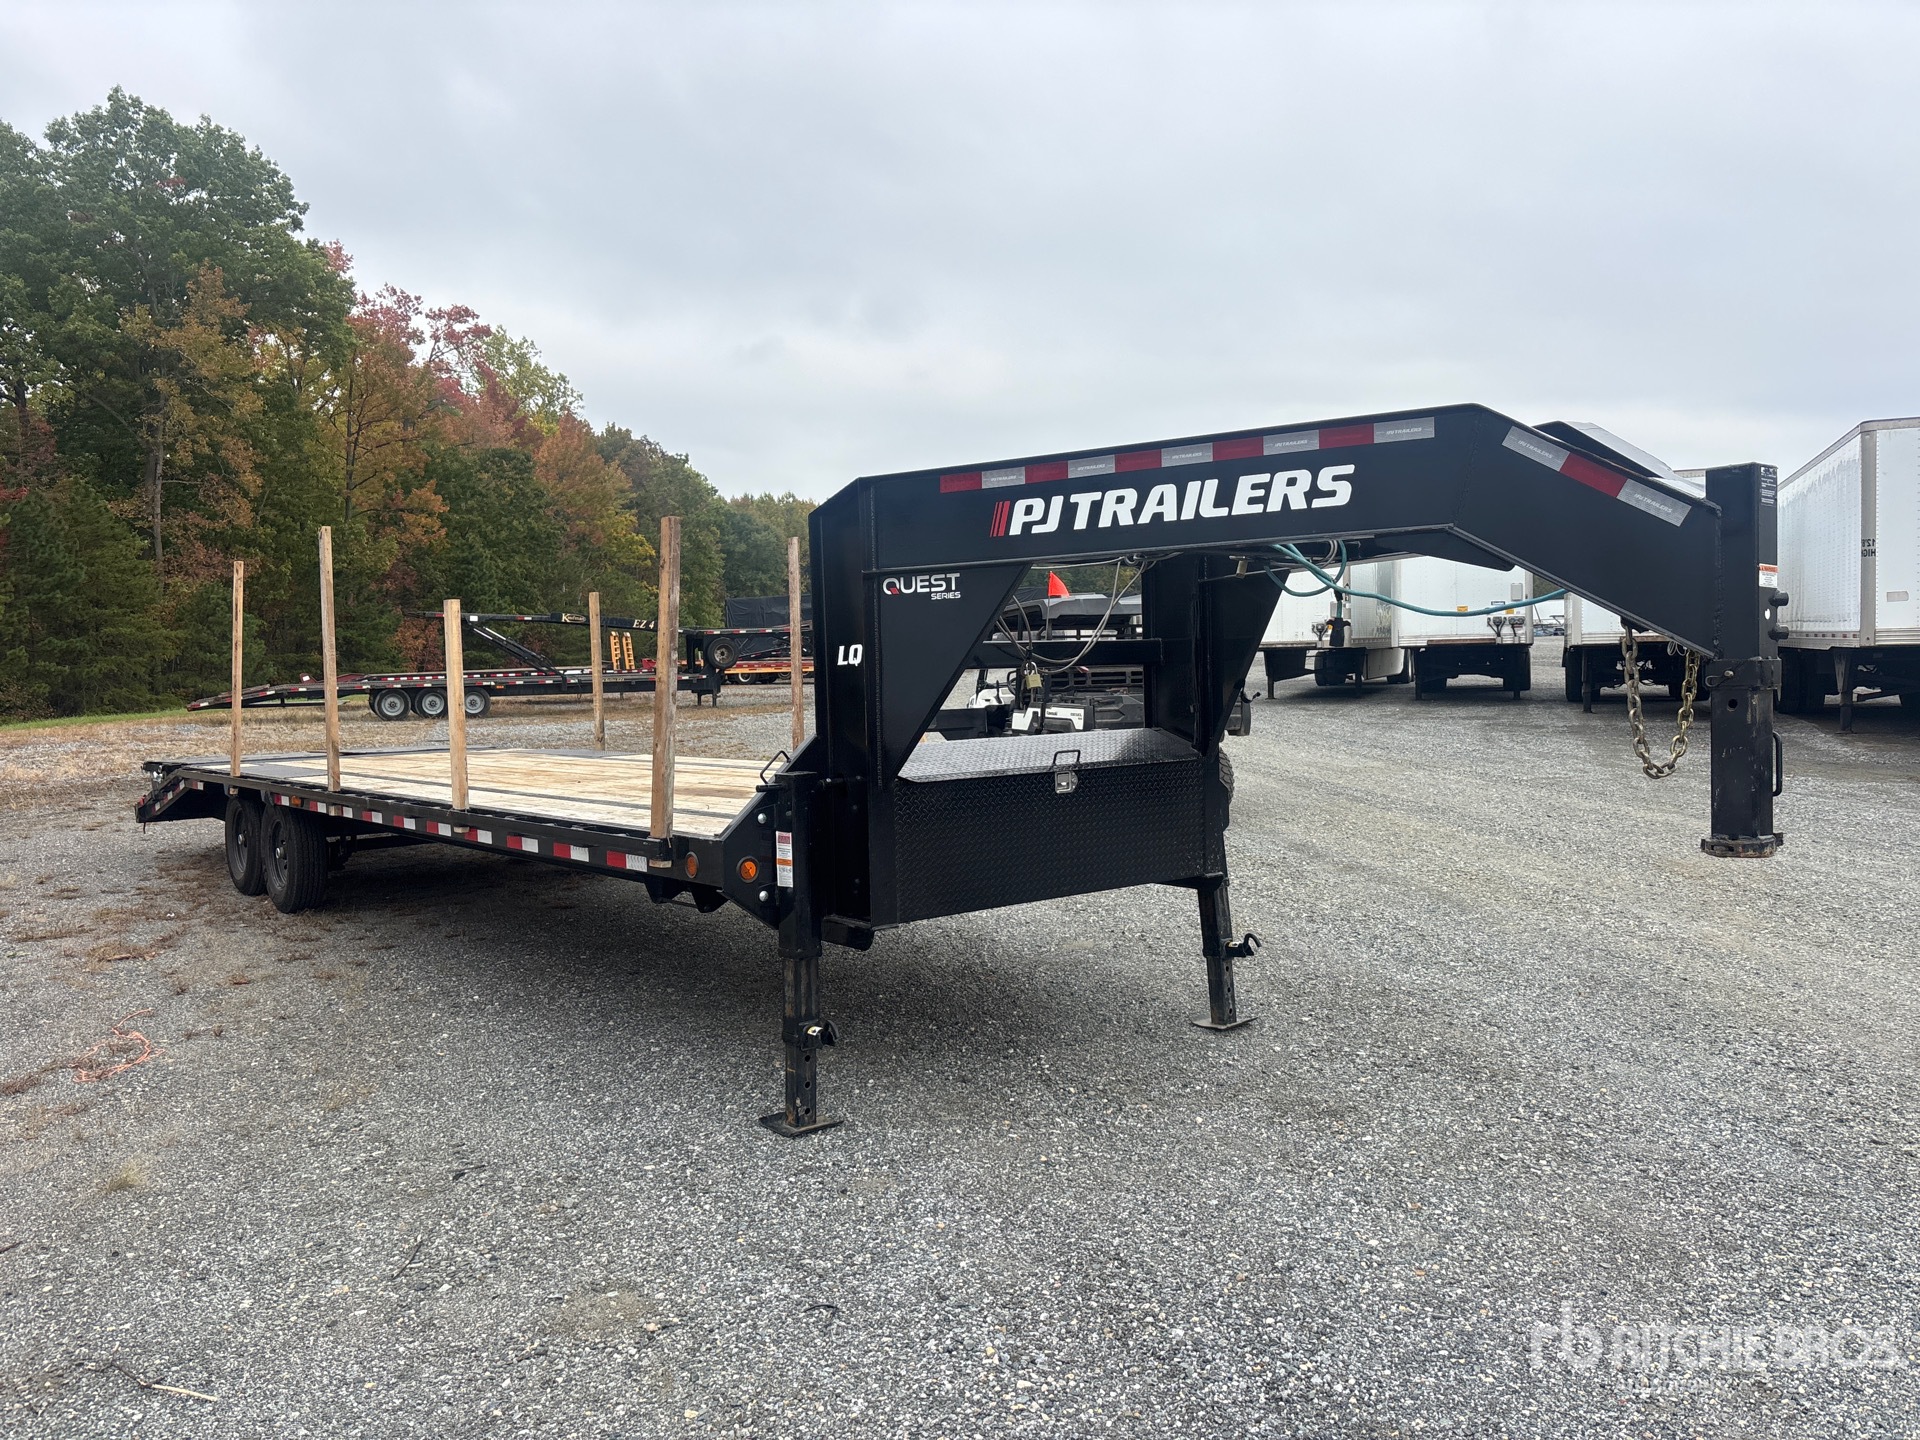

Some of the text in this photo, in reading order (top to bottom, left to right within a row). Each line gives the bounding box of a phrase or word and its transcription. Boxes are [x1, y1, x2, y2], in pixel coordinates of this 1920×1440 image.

[1069, 464, 1355, 530] TRAILERS
[882, 572, 960, 595] QUEST
[931, 591, 961, 600] SERIES
[837, 643, 863, 667] LQ
